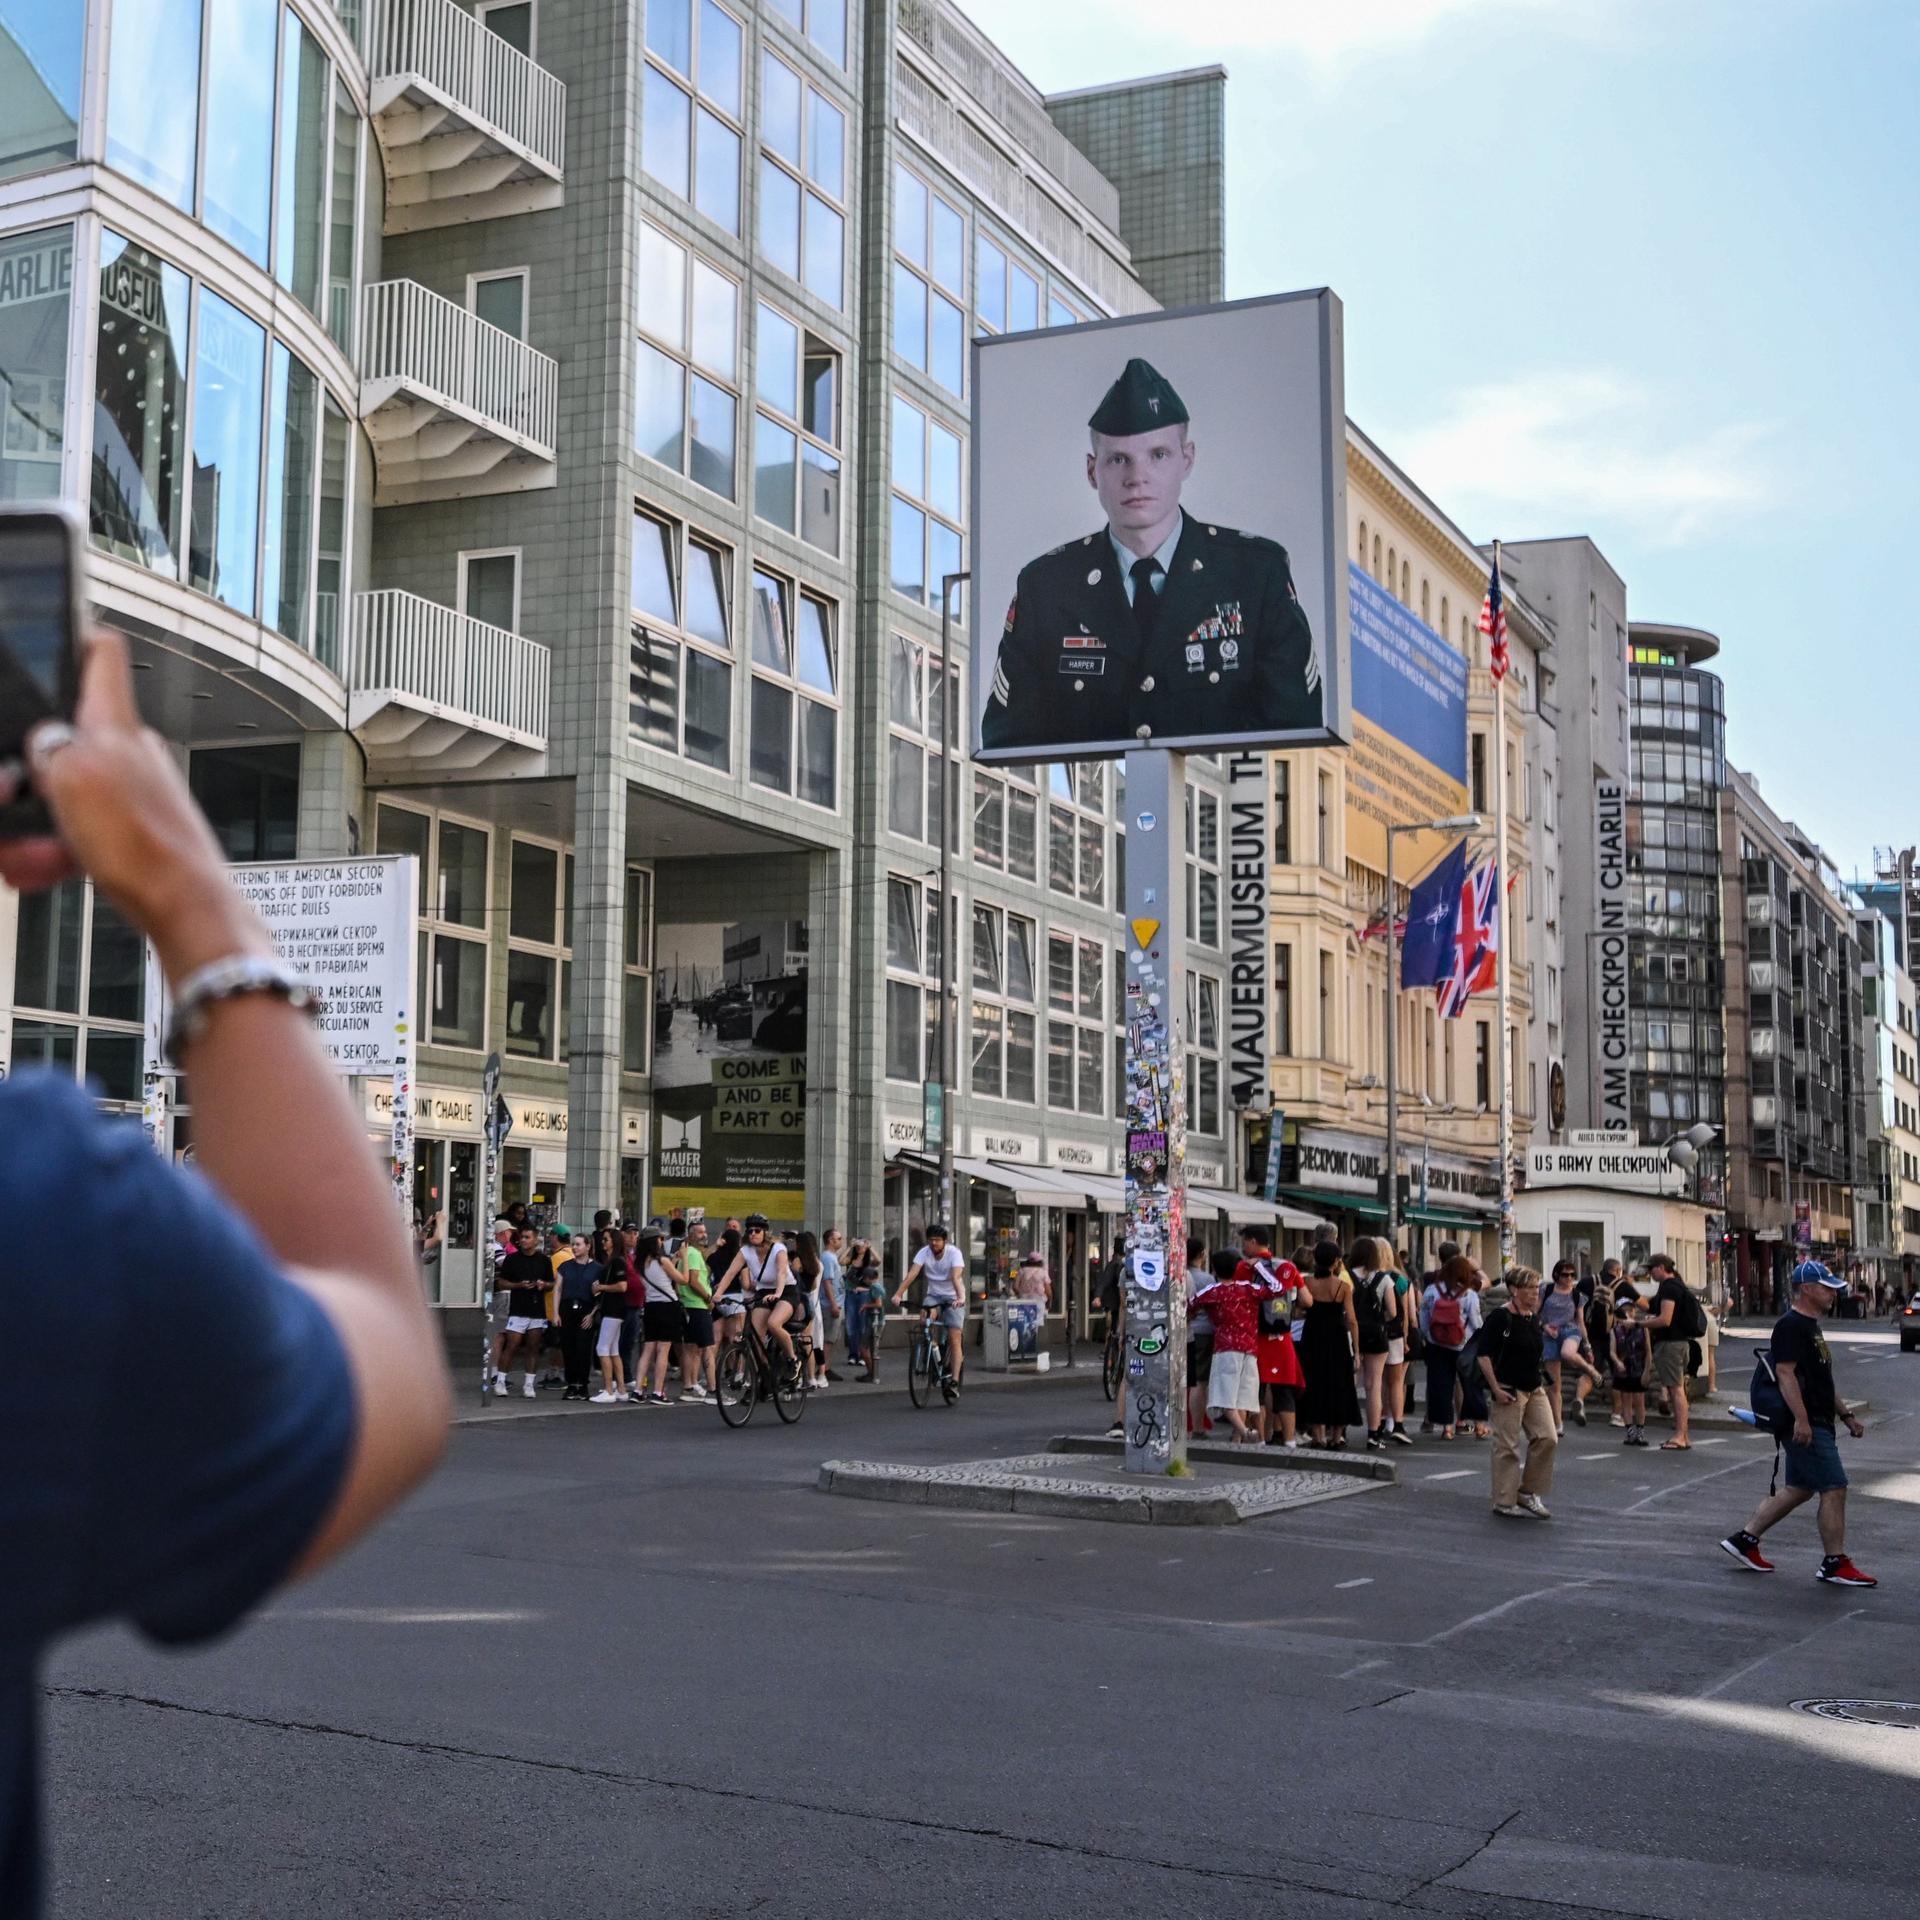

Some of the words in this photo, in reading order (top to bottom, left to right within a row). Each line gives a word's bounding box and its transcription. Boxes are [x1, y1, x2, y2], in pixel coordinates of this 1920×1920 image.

[1068, 660, 1095, 670] HARPER
[1600, 786, 1623, 890] CHARLIE
[275, 870, 289, 884] THE
[294, 868, 342, 882] AMERICAN
[347, 865, 384, 880] SECTOR
[279, 885, 296, 900] OFF
[302, 884, 325, 900] DUTY
[329, 882, 382, 898] FORBIDDEN
[261, 903, 297, 917] TRAFFIC
[302, 901, 330, 916] RULES
[343, 925, 378, 940] СЕКТОР
[357, 942, 385, 956] ВРЕМЯ
[1231, 802, 1265, 1098] MAUERMUSEUM
[1601, 898, 1626, 1061] CHECKPONT
[337, 1001, 348, 1014] DU
[350, 1000, 383, 1014] SERVICE
[344, 1044, 380, 1059] SEKTOR
[721, 1059, 780, 1079] COME
[725, 1087, 761, 1104] AND
[770, 1086, 792, 1103] BE
[1604, 1067, 1627, 1110] AM
[375, 1094, 431, 1118] CHEOINT
[435, 1099, 472, 1122] CHARLIE
[720, 1111, 770, 1128] PART
[780, 1110, 805, 1128] OF
[1000, 1138, 1022, 1155] MUSEUM
[660, 1152, 701, 1167] MAUER
[1535, 1155, 1552, 1172] US
[1559, 1155, 1593, 1173] ARMY
[1599, 1155, 1672, 1174] CHECKPOINT
[660, 1166, 701, 1178] MUSEUM
[756, 1176, 787, 1184] Freedom
